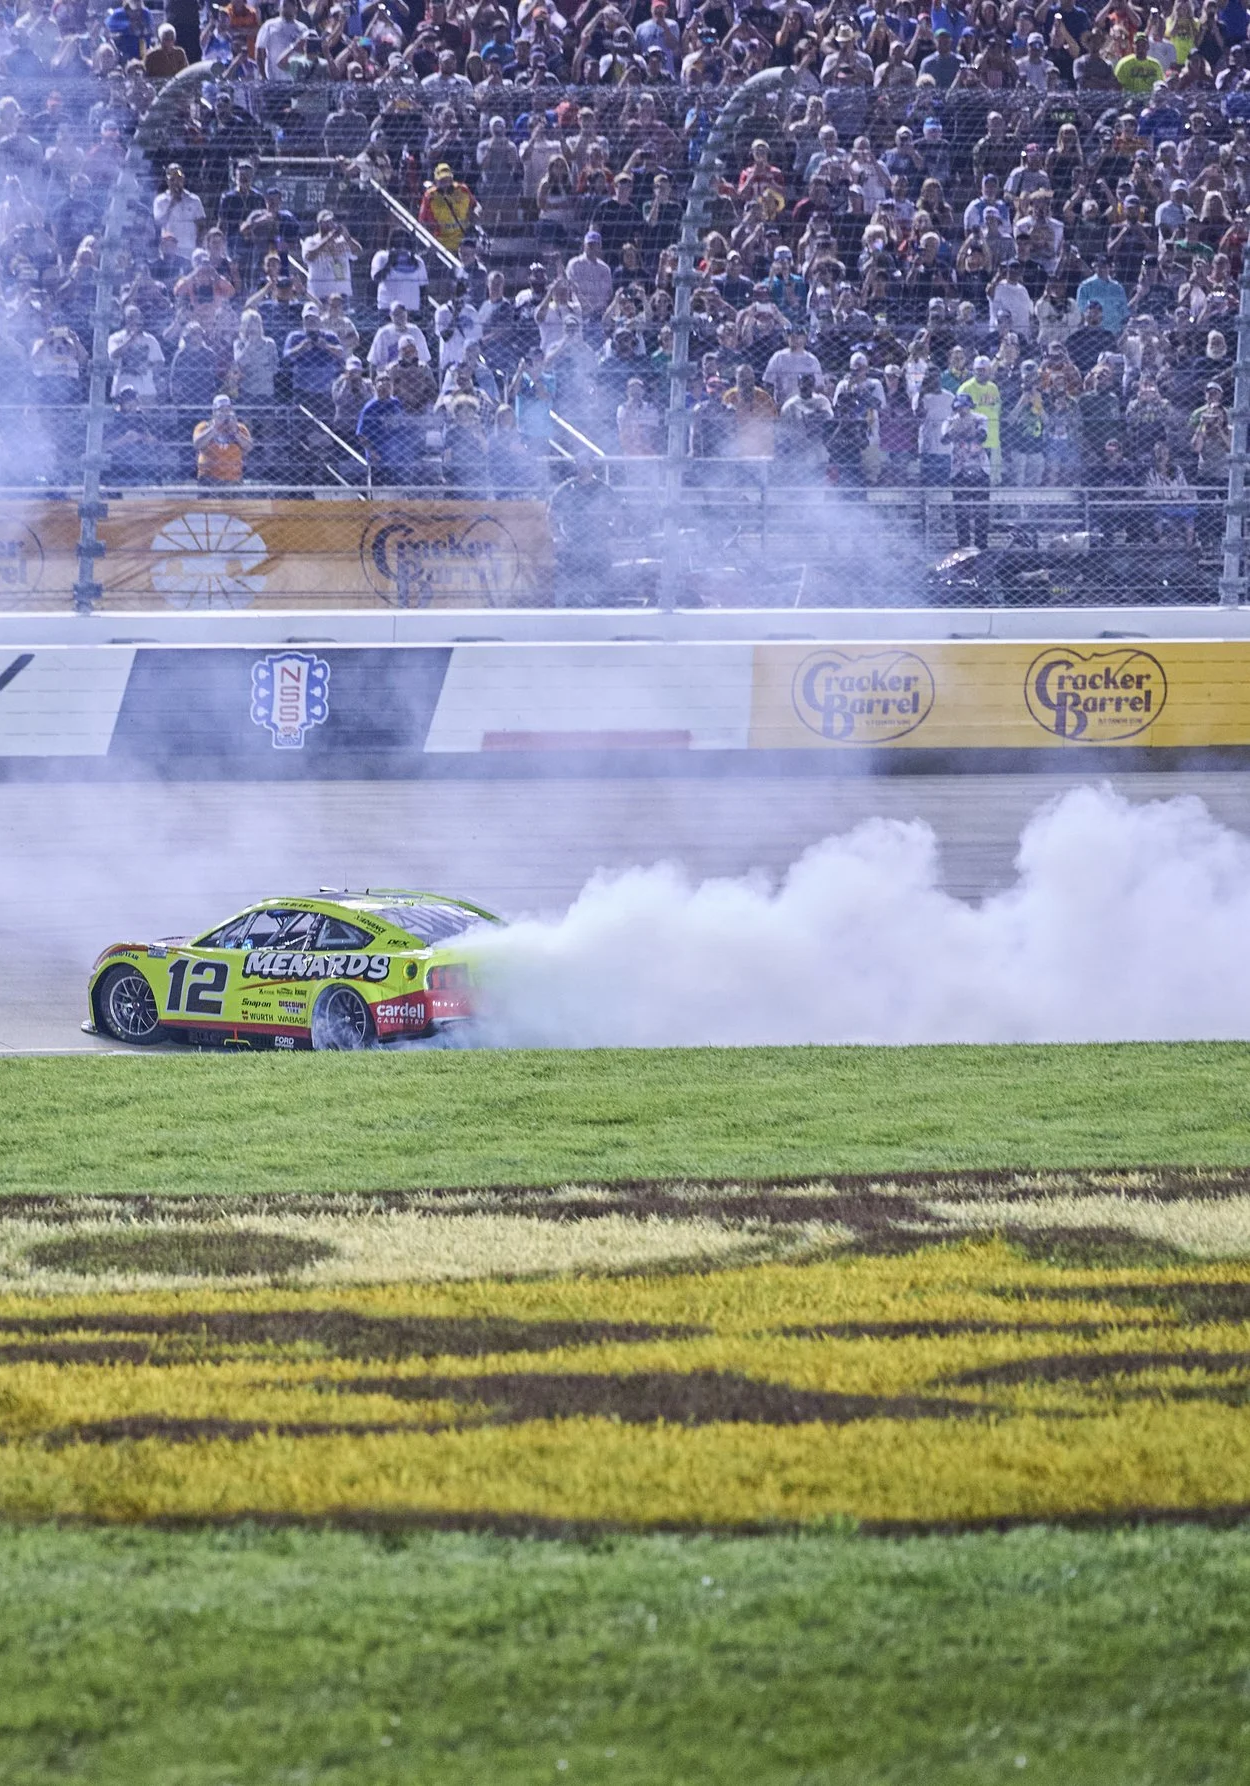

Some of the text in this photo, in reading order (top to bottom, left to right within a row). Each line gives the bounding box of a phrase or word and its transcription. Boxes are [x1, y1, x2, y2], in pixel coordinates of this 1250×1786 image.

[802, 660, 920, 712] Cracker
[1035, 659, 1152, 711] Cracker
[822, 691, 921, 739] Barrel
[1054, 690, 1153, 738] Barrel
[244, 952, 390, 981] MENARDS
[166, 958, 230, 1016] 12
[279, 1000, 306, 1009] DISCOUNT
[376, 1003, 425, 1019] cardell
[377, 1017, 425, 1025] CABINETRY
[275, 1036, 295, 1045] FORD
